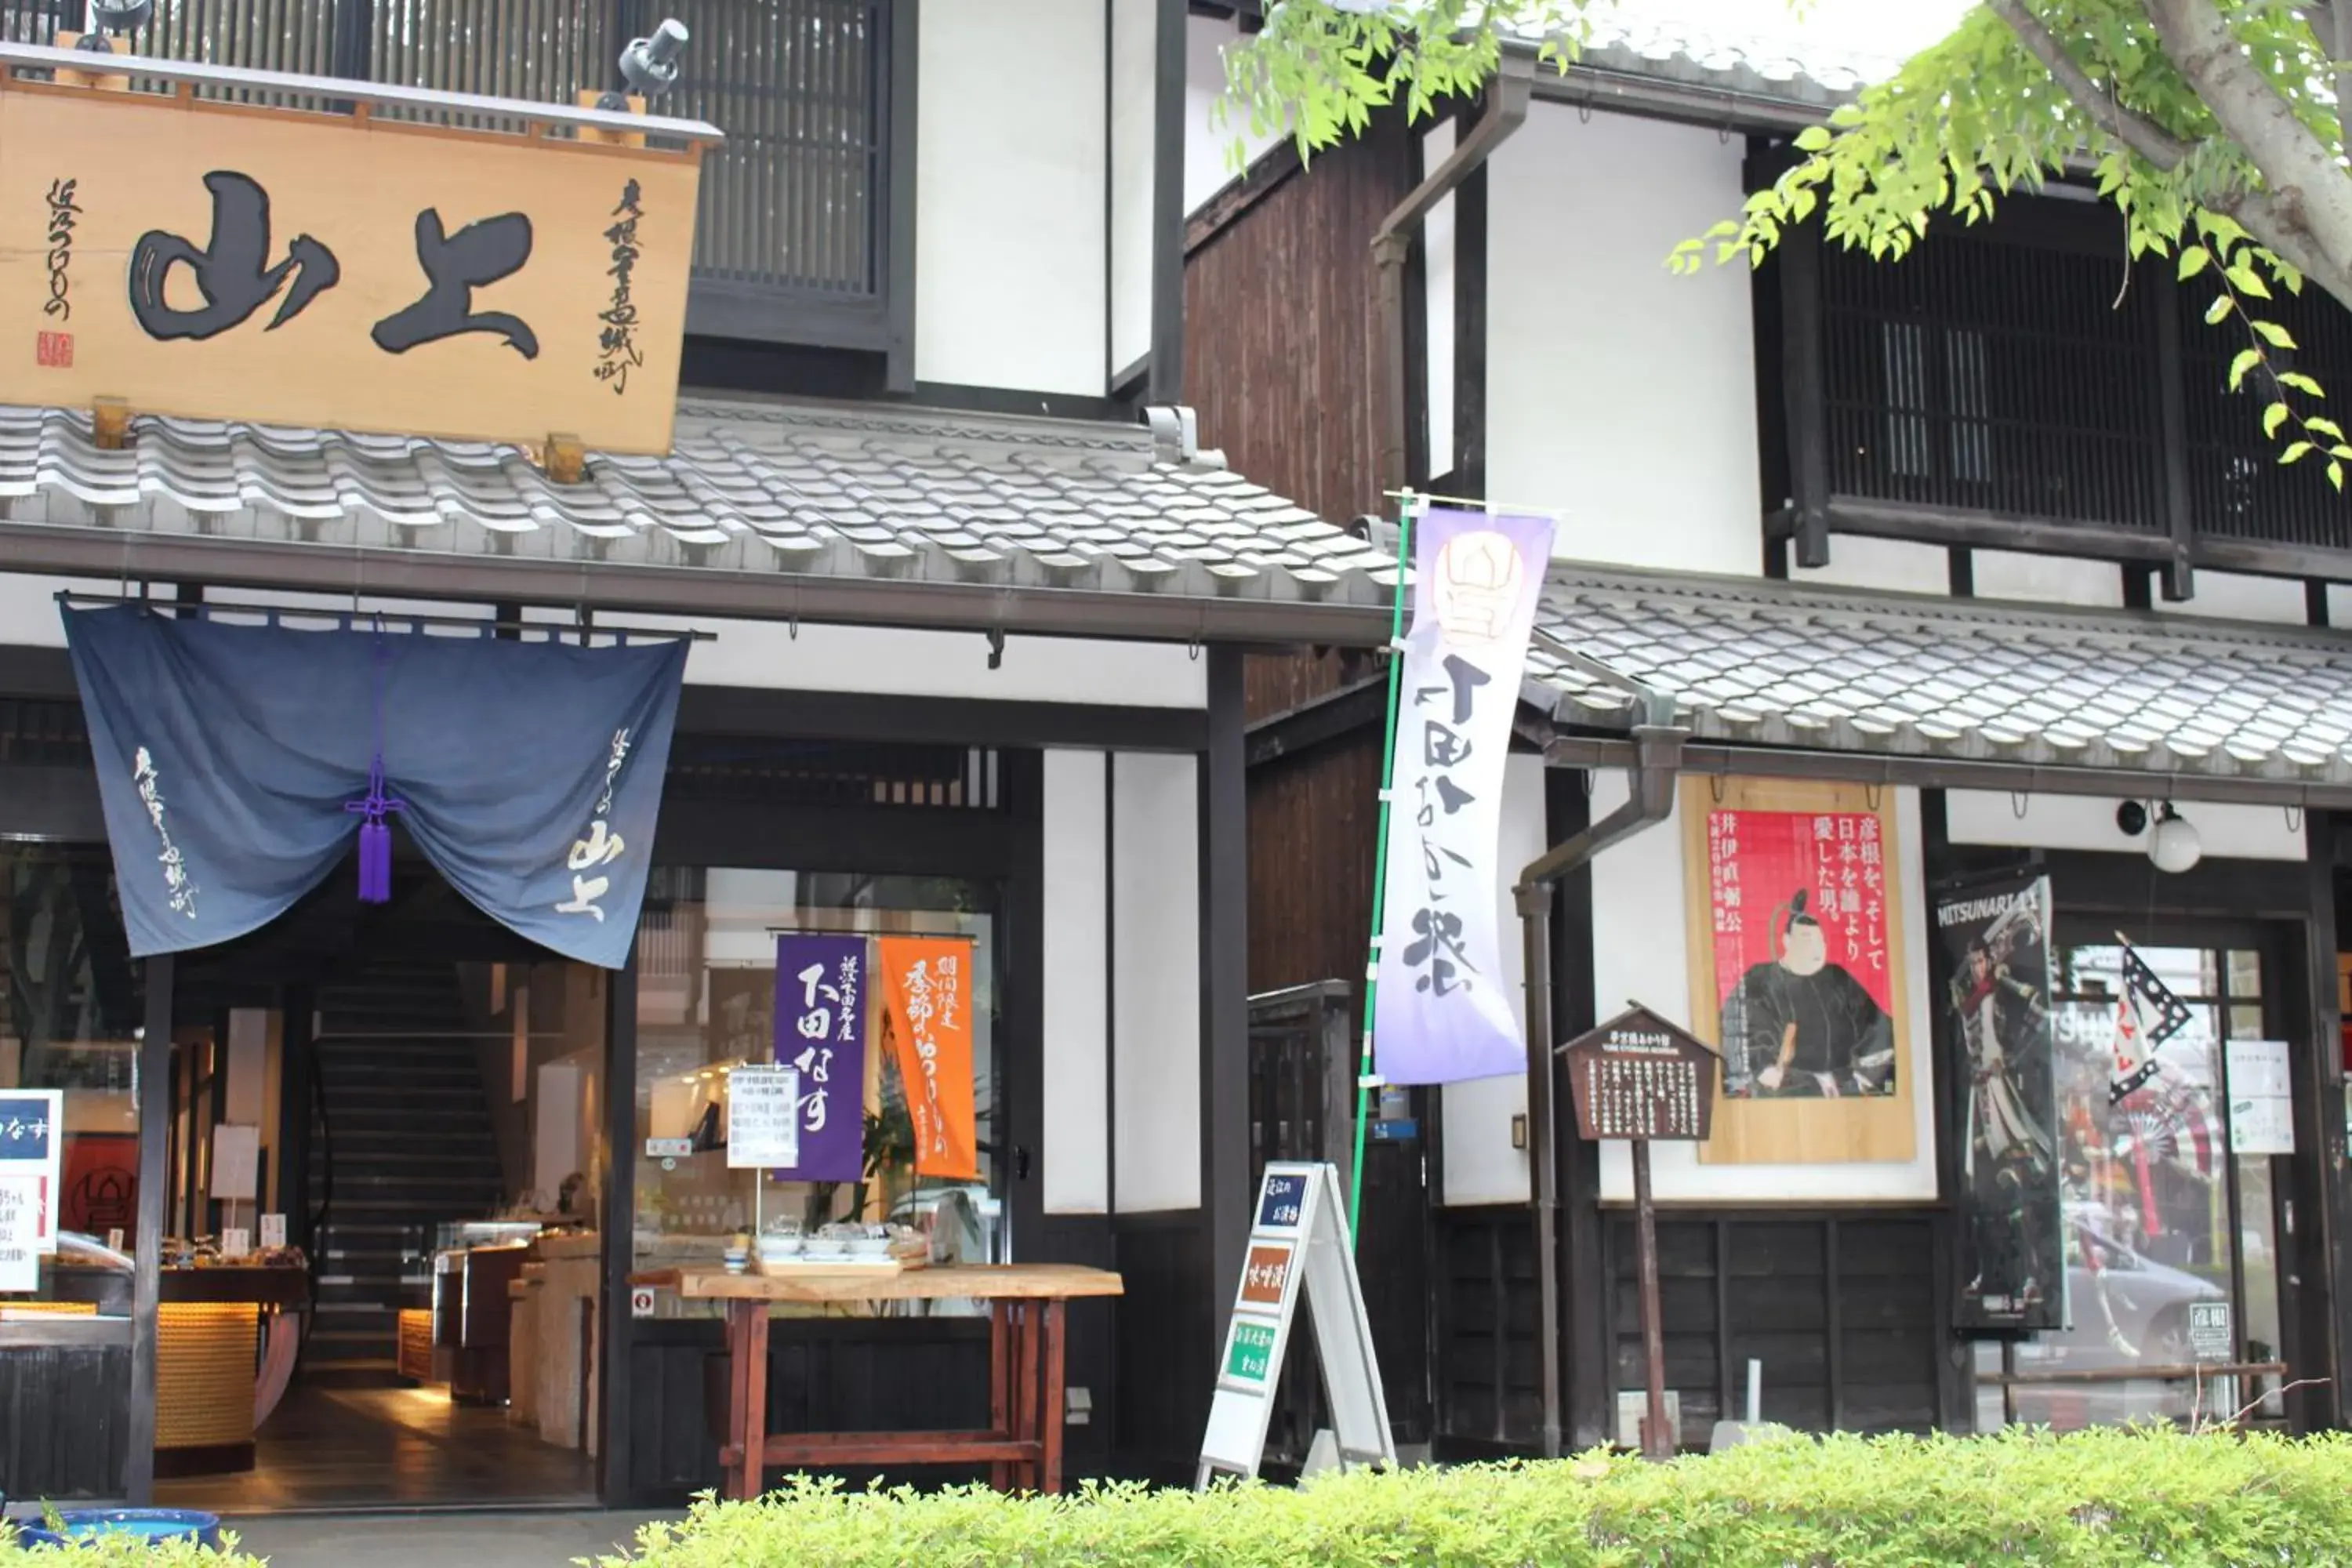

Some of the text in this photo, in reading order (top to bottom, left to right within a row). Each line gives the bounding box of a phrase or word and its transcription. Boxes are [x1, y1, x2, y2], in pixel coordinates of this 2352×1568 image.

[554, 819, 625, 922] 山上
[1813, 816, 1839, 922] 愛した男。
[1860, 816, 1883, 970] 彦根を、そして
[794, 963, 840, 1132] 下田なす
